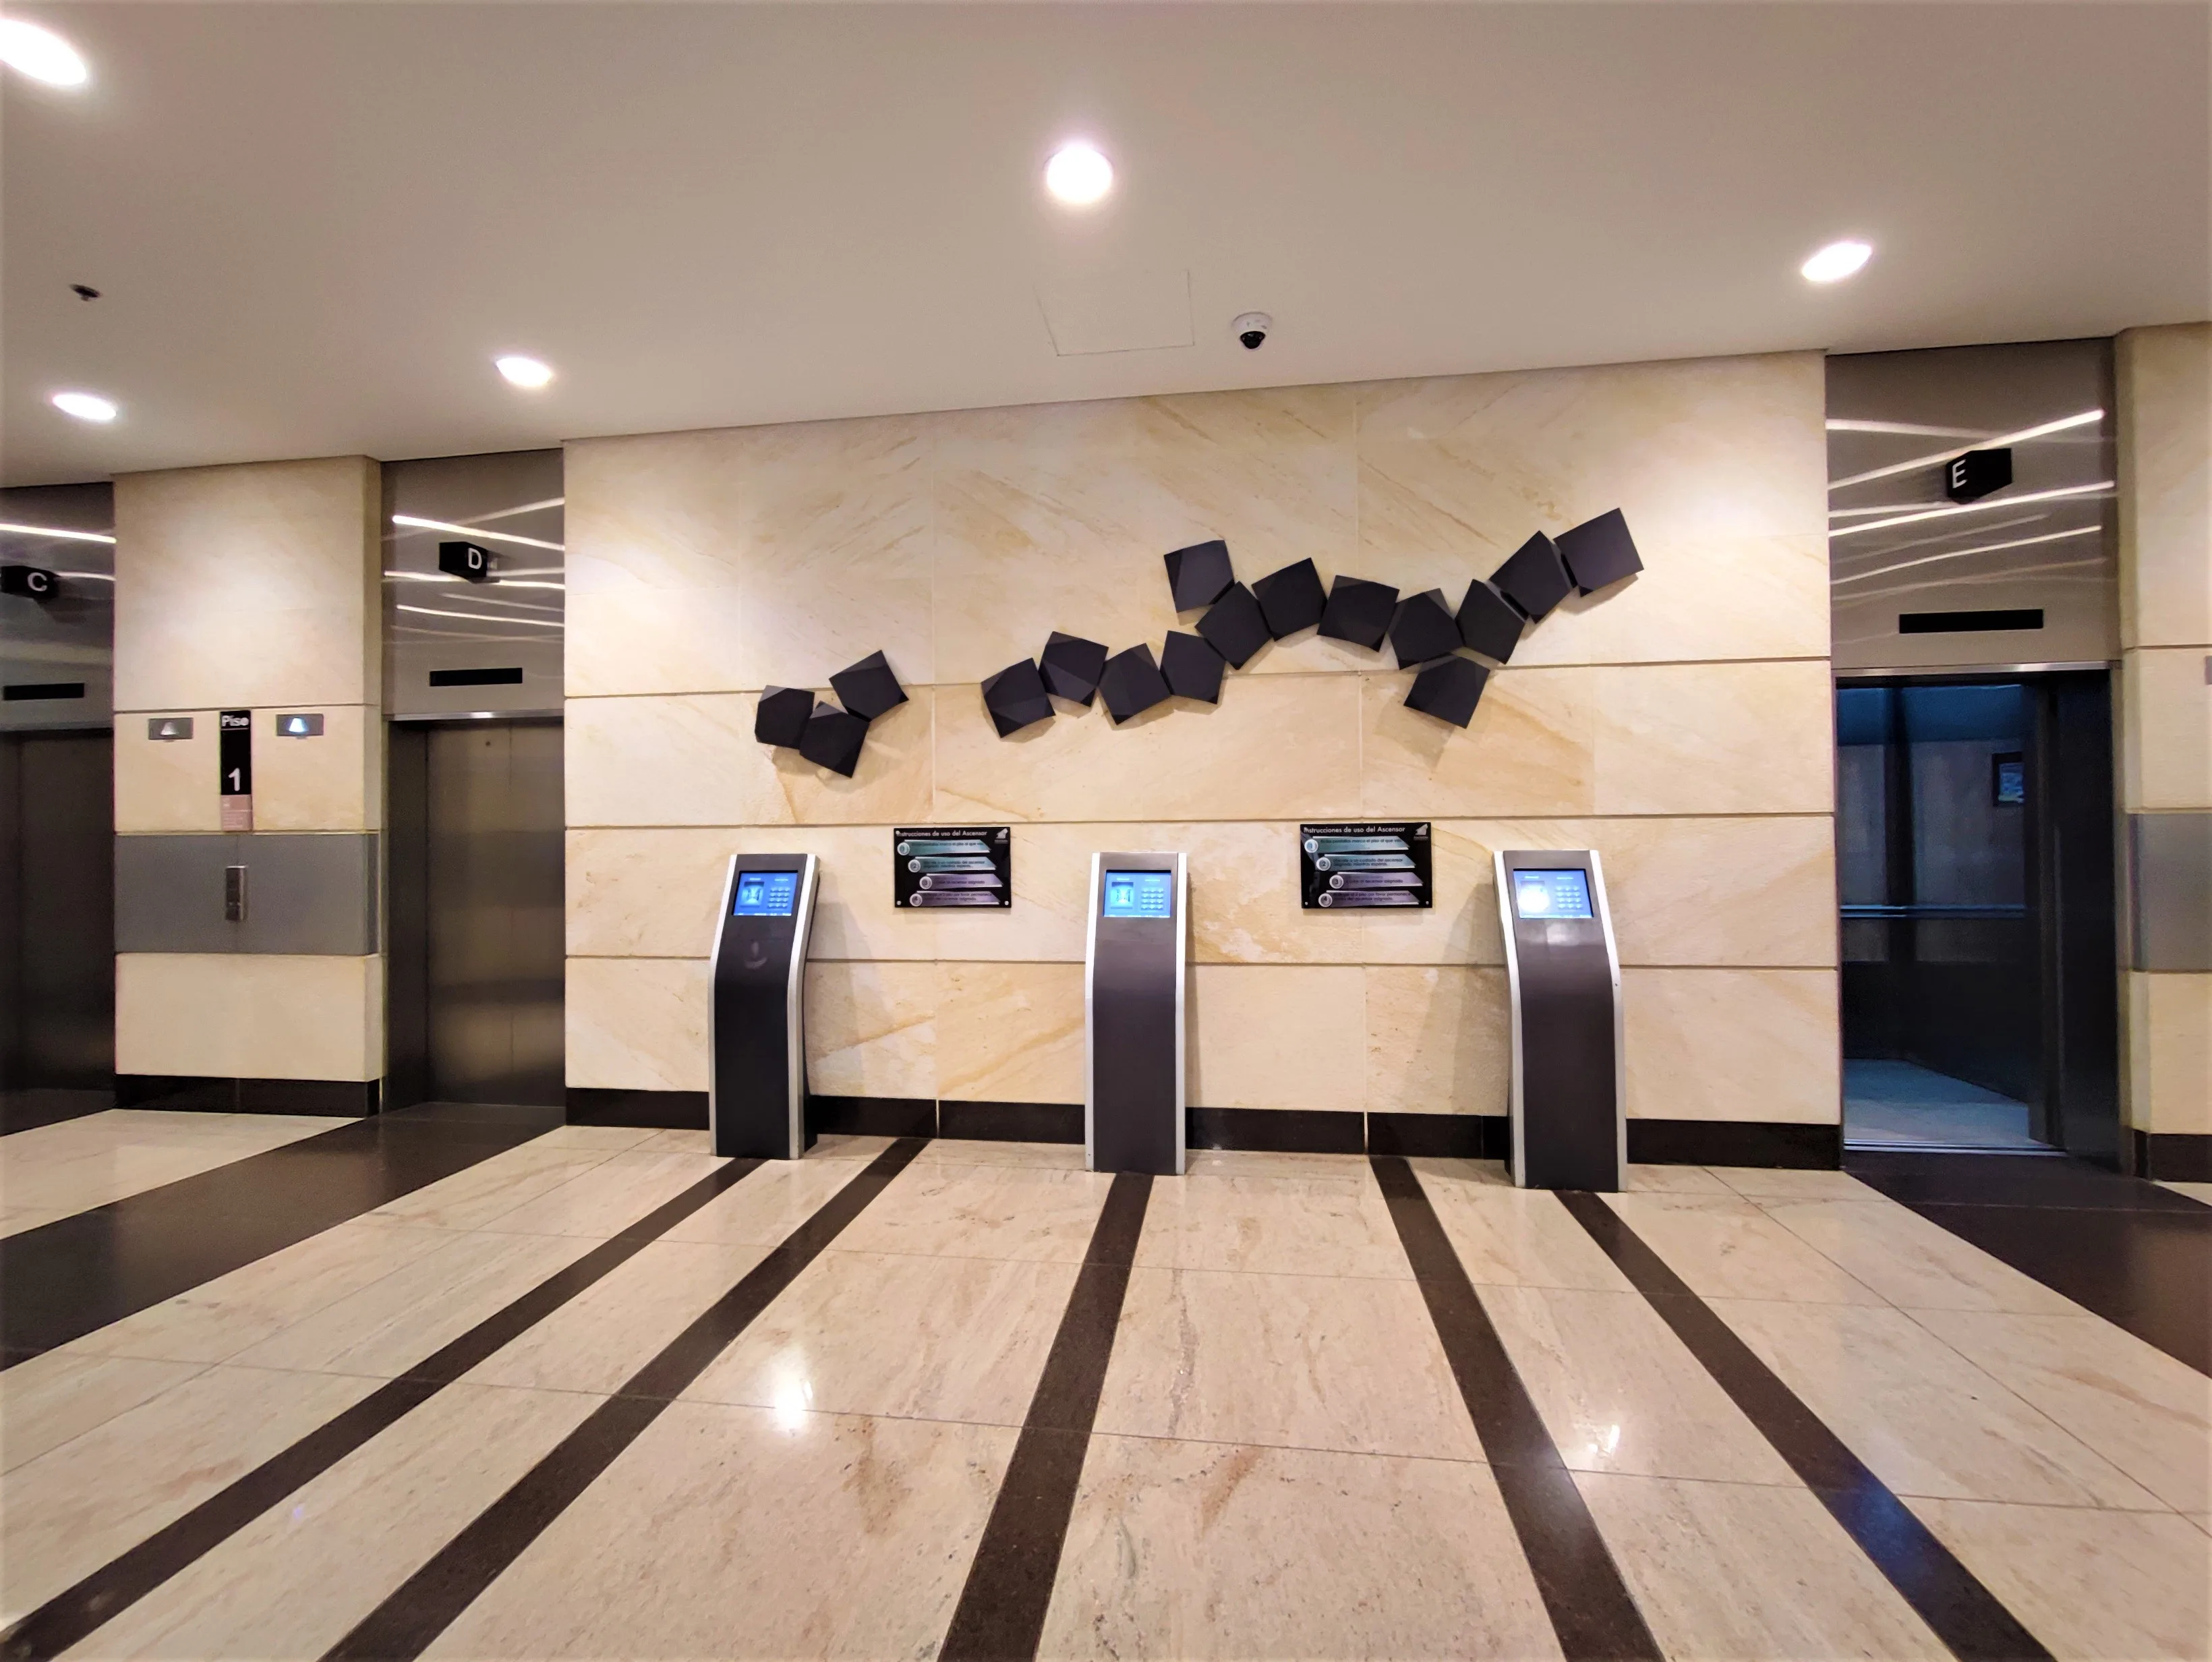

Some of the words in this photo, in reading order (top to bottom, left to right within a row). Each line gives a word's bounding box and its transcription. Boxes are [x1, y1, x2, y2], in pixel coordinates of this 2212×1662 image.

[1952, 459, 1968, 489] E
[468, 547, 482, 569] D
[27, 572, 48, 592] C
[222, 715, 250, 726] Piso
[228, 768, 241, 791] 1
